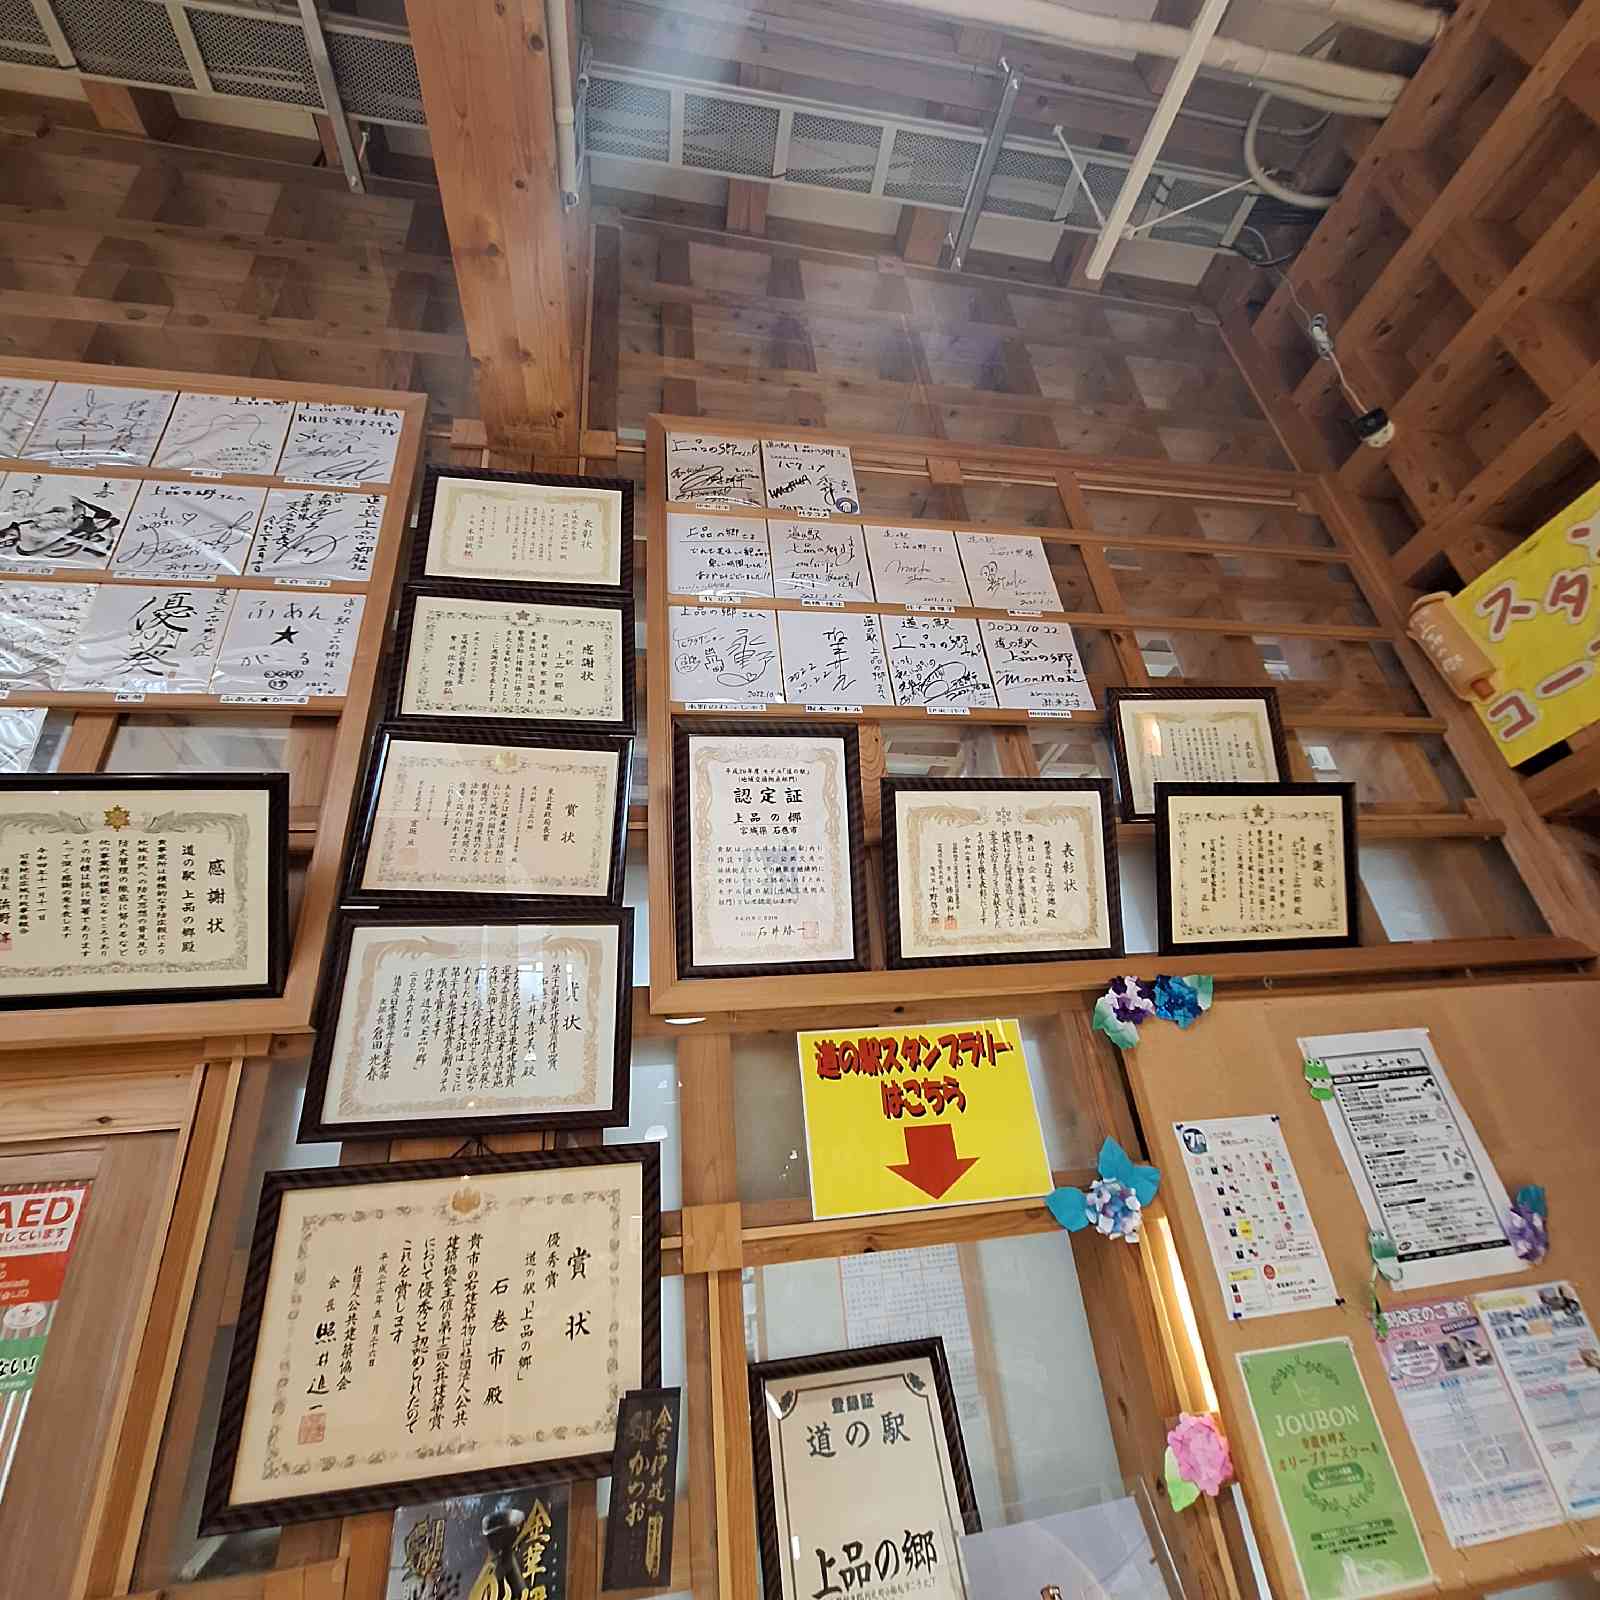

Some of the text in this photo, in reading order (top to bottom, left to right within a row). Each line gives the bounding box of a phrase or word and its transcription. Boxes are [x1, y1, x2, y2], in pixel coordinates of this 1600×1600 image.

[580, 643, 595, 681] 感謝状
[733, 786, 804, 804] 認定証
[733, 811, 802, 824] 上品の郷
[560, 803, 579, 844] 賞状
[740, 826, 798, 836] 宮城県 石巻市
[1061, 841, 1079, 893] 表彰状
[181, 843, 196, 953] 道の駅 上品の郷殿
[207, 857, 226, 935] 感謝状
[813, 1029, 1014, 1080] 道の駅スタンプラリー
[880, 1075, 967, 1119] はこちら
[545, 1231, 561, 1290] 優秀賞
[325, 1274, 341, 1313] 会長
[390, 1239, 412, 1344] これを賞します
[516, 1250, 537, 1381] 道の駅「上品の郷」
[564, 1246, 592, 1341] 賞状
[336, 1265, 363, 1391] 社団法人公共建築協会
[405, 1237, 436, 1434] において優秀と認められたので
[483, 1277, 510, 1406] 石巻市殿
[831, 1391, 875, 1414] 登録証
[1274, 1405, 1361, 1438] JOUBON
[806, 1411, 911, 1458] 道の駅
[812, 1528, 938, 1600] 上品の郷
